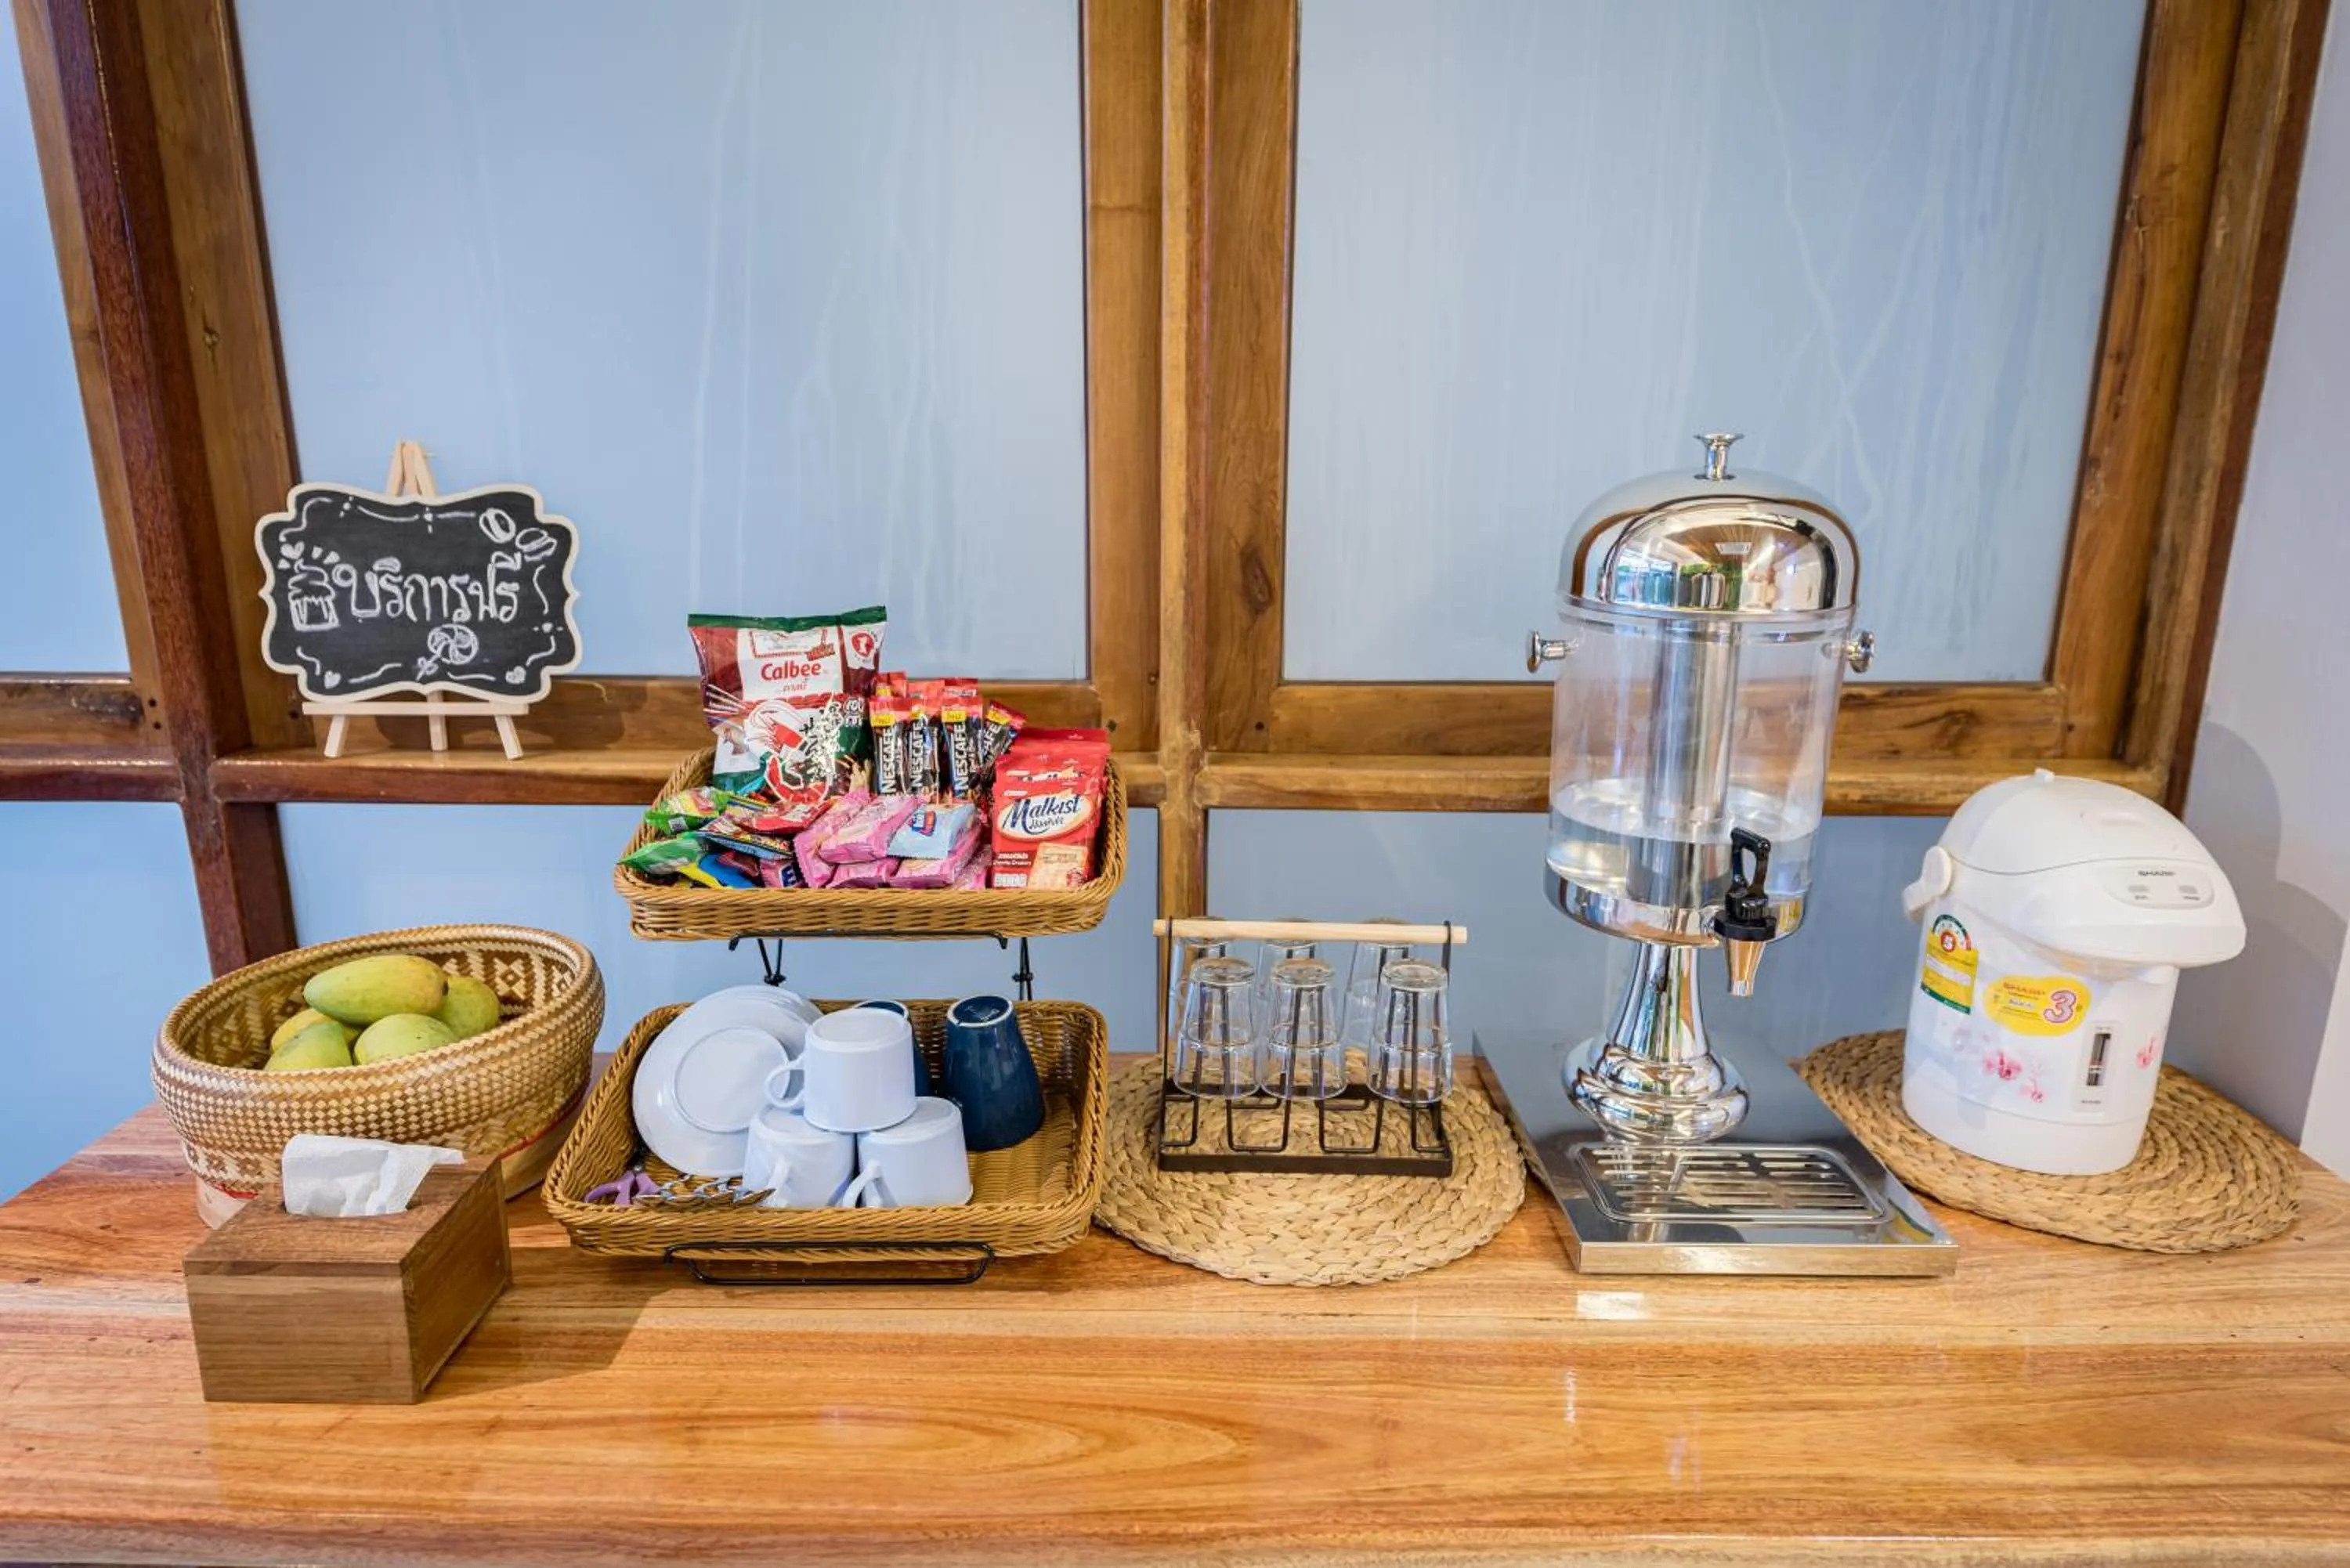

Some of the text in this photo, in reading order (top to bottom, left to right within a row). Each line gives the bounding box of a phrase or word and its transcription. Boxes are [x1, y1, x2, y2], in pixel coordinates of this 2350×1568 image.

[331, 551, 522, 623] บริการฟรี
[761, 660, 822, 681] Calbee
[1002, 794, 1080, 833] Malkist
[2043, 989, 2077, 1024] 3
